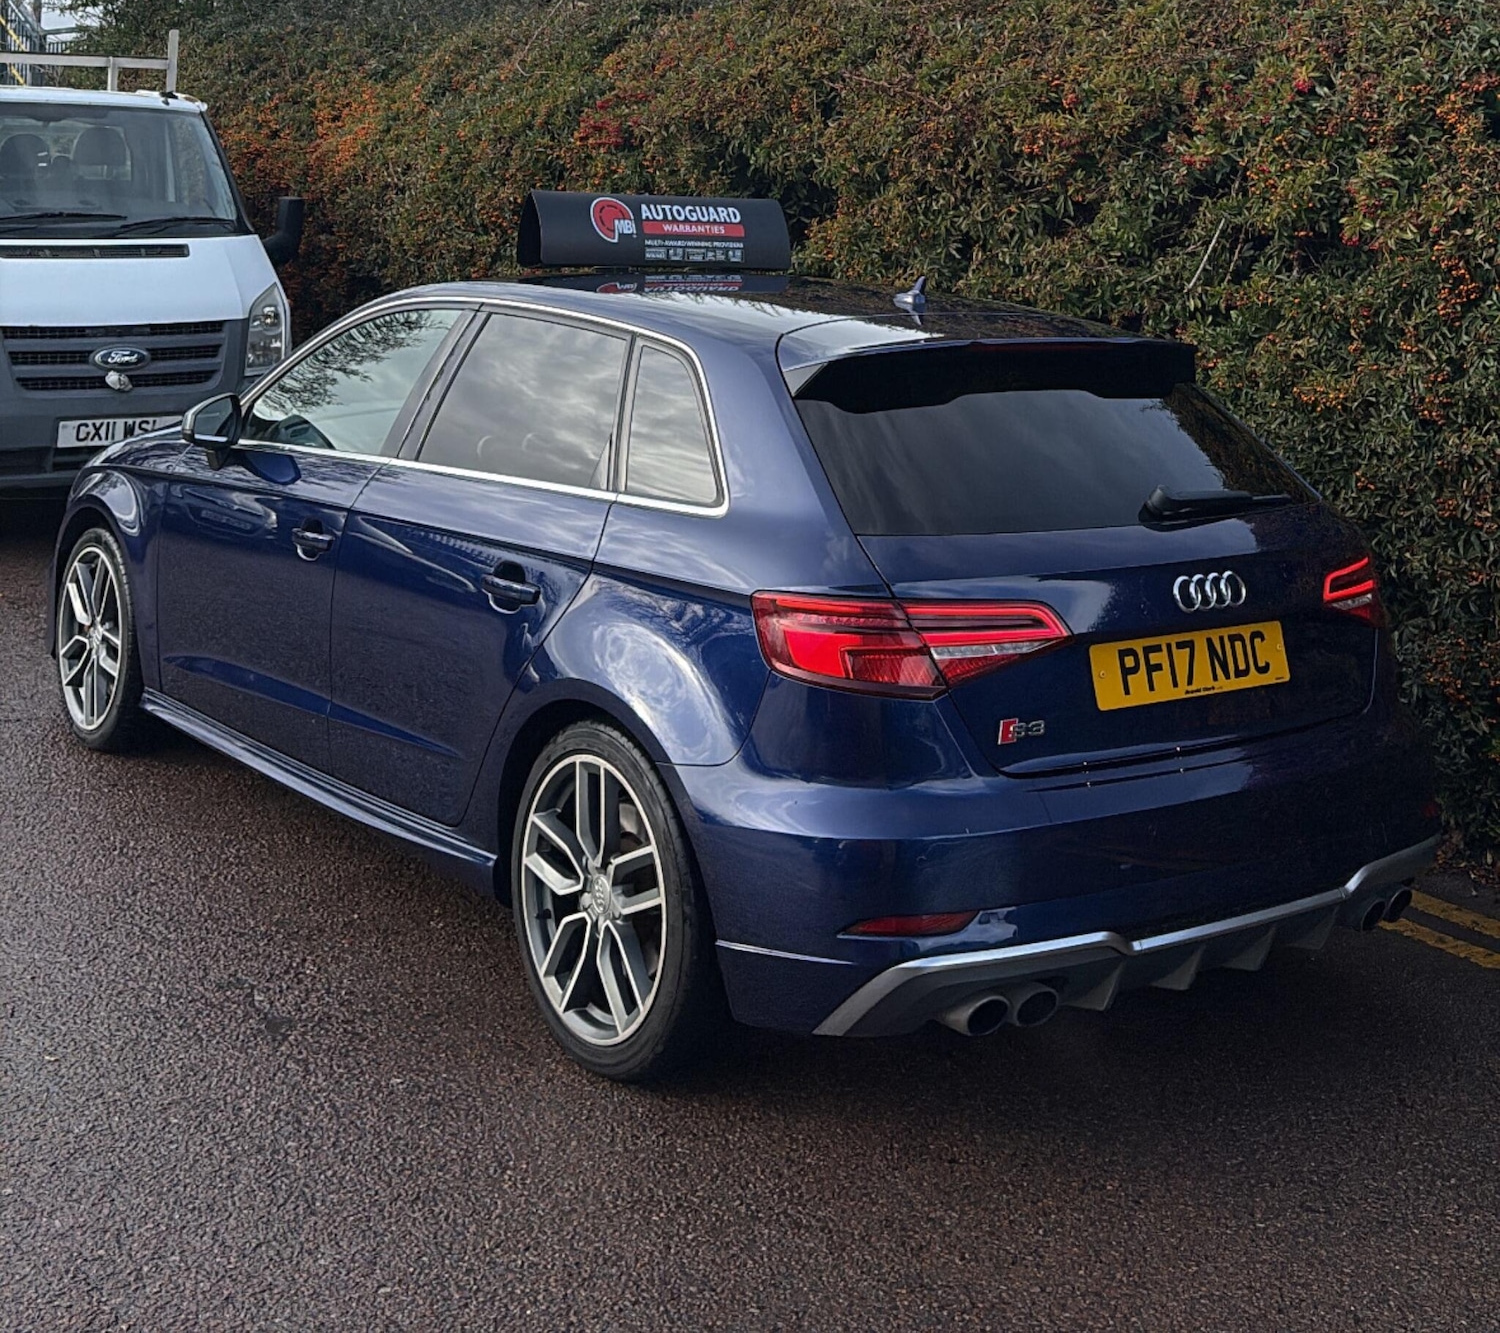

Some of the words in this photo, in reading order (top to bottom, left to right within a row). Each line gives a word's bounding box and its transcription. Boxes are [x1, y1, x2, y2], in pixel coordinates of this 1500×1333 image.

[641, 204, 741, 223] AUTOGUARD
[663, 223, 725, 235] WARRANTIES
[107, 350, 138, 363] Ford
[1117, 639, 1195, 696] PF17
[1205, 630, 1271, 683] NDC
